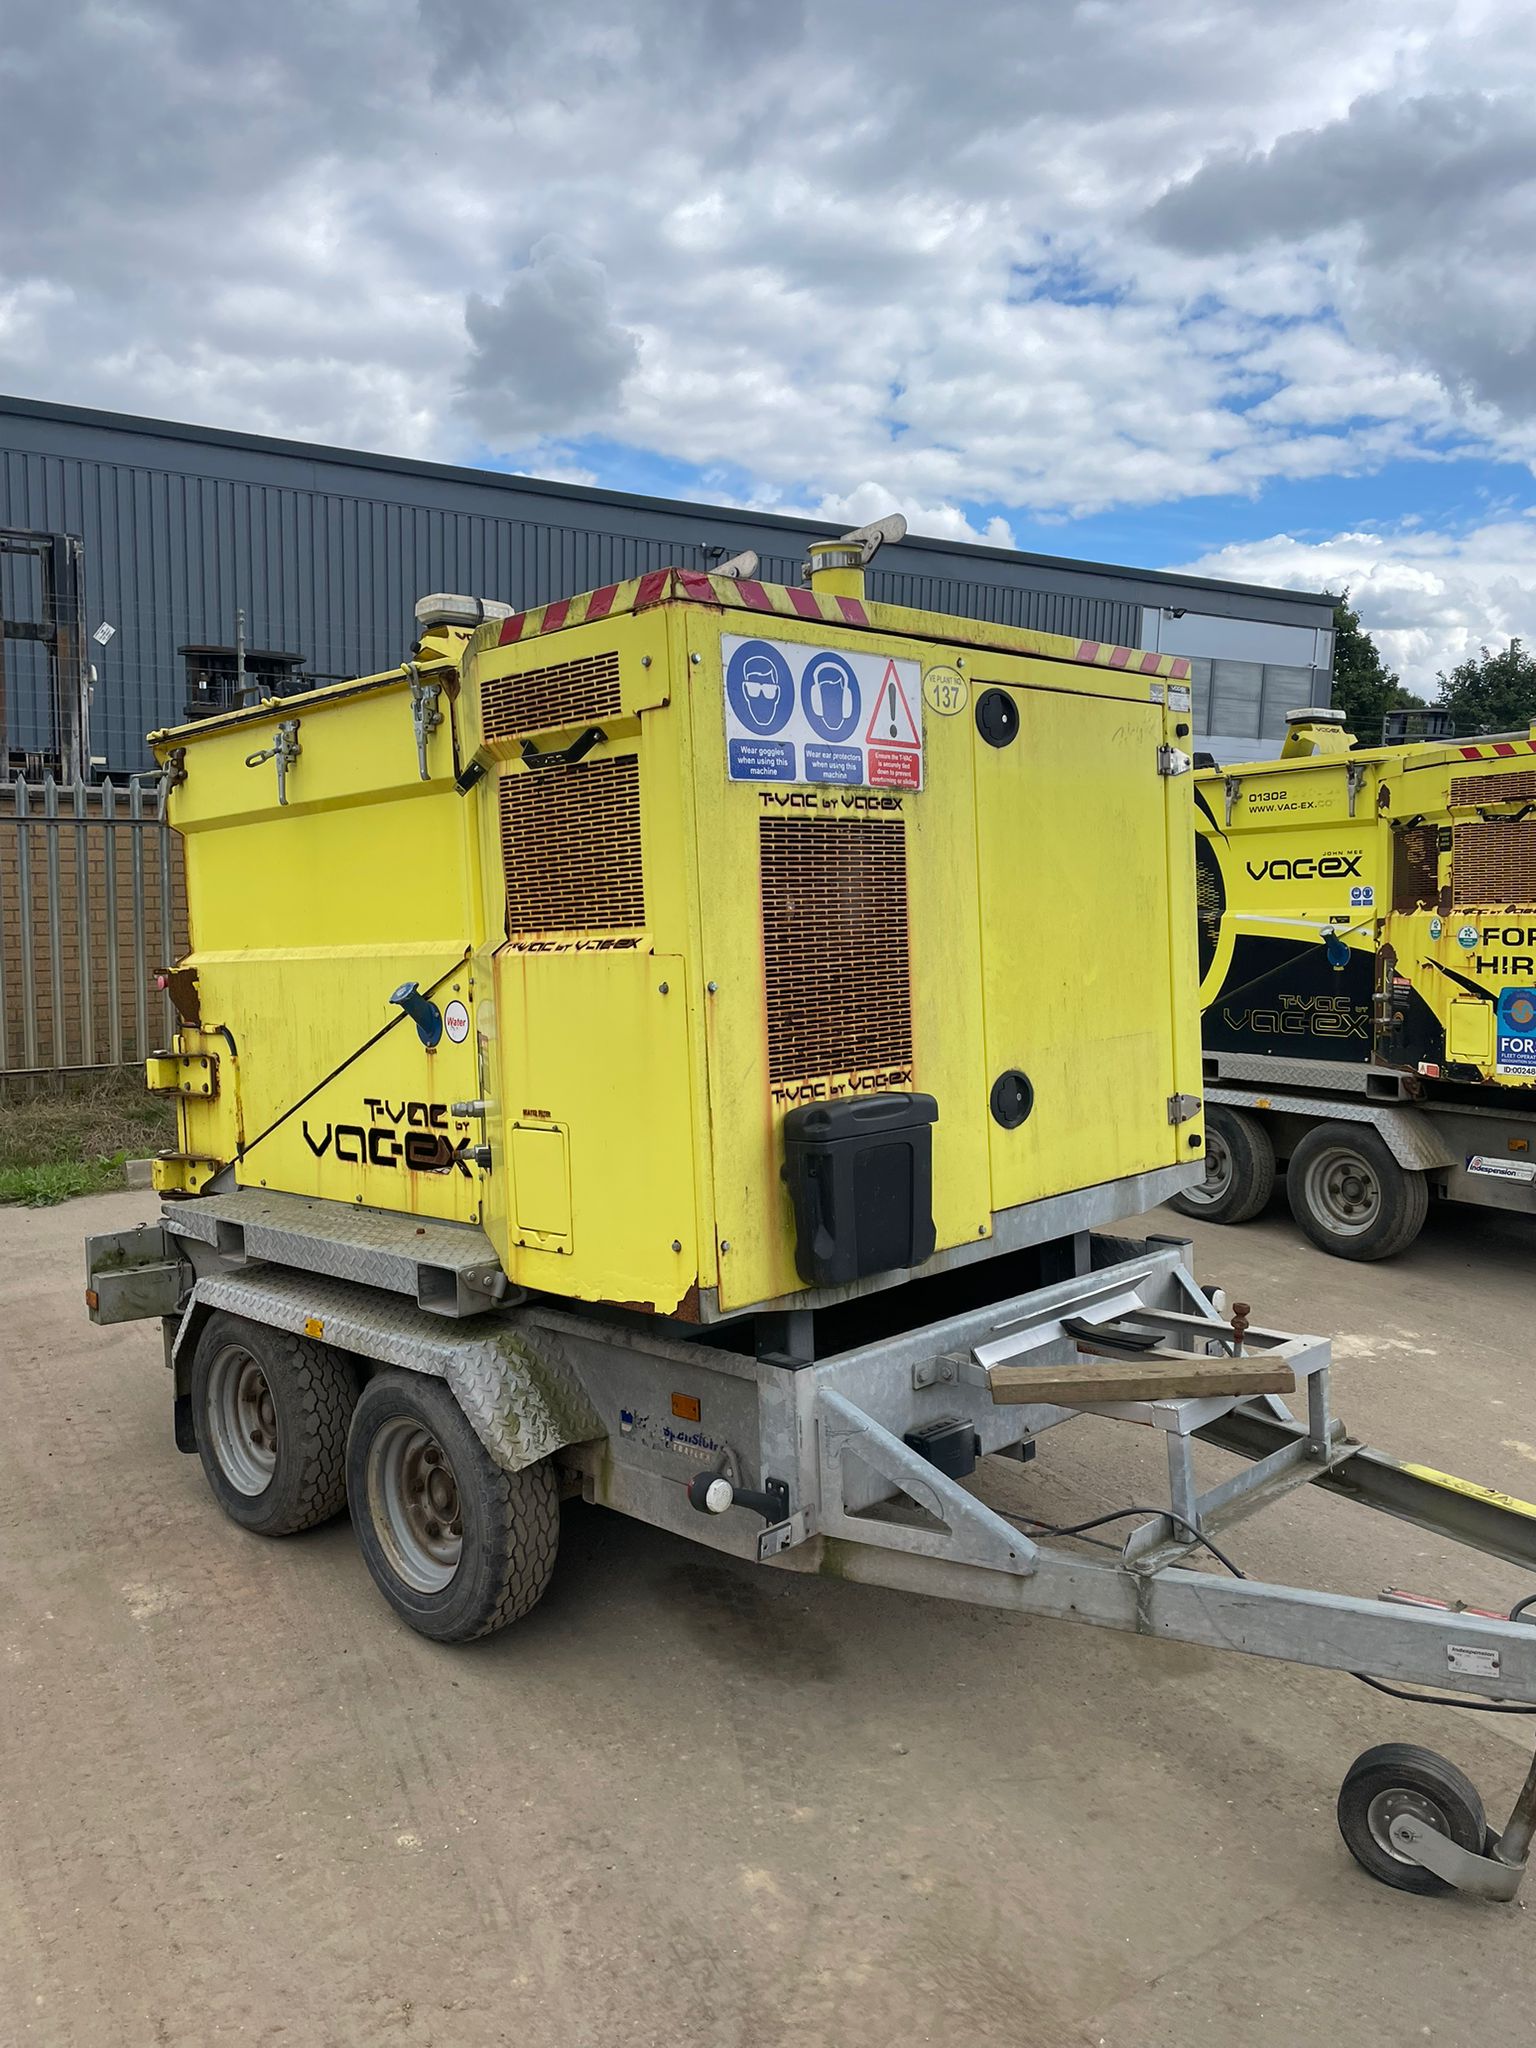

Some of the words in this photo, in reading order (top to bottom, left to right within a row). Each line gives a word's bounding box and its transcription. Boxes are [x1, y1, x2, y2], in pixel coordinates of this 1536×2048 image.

[933, 685, 959, 709] 137
[740, 745, 758, 754] Wear
[759, 748, 785, 757] goggles
[805, 750, 821, 758] Wear
[833, 753, 861, 761] protectors
[875, 752, 891, 760] Ensure
[737, 756, 756, 764] when
[757, 757, 775, 767] using
[776, 758, 788, 766] this
[812, 760, 828, 768] when
[829, 762, 845, 771] using
[750, 767, 778, 776] machine
[823, 771, 848, 779] machine
[1248, 791, 1288, 803] 01302
[447, 1017, 466, 1027] Water
[1501, 1037, 1536, 1054] FOR
